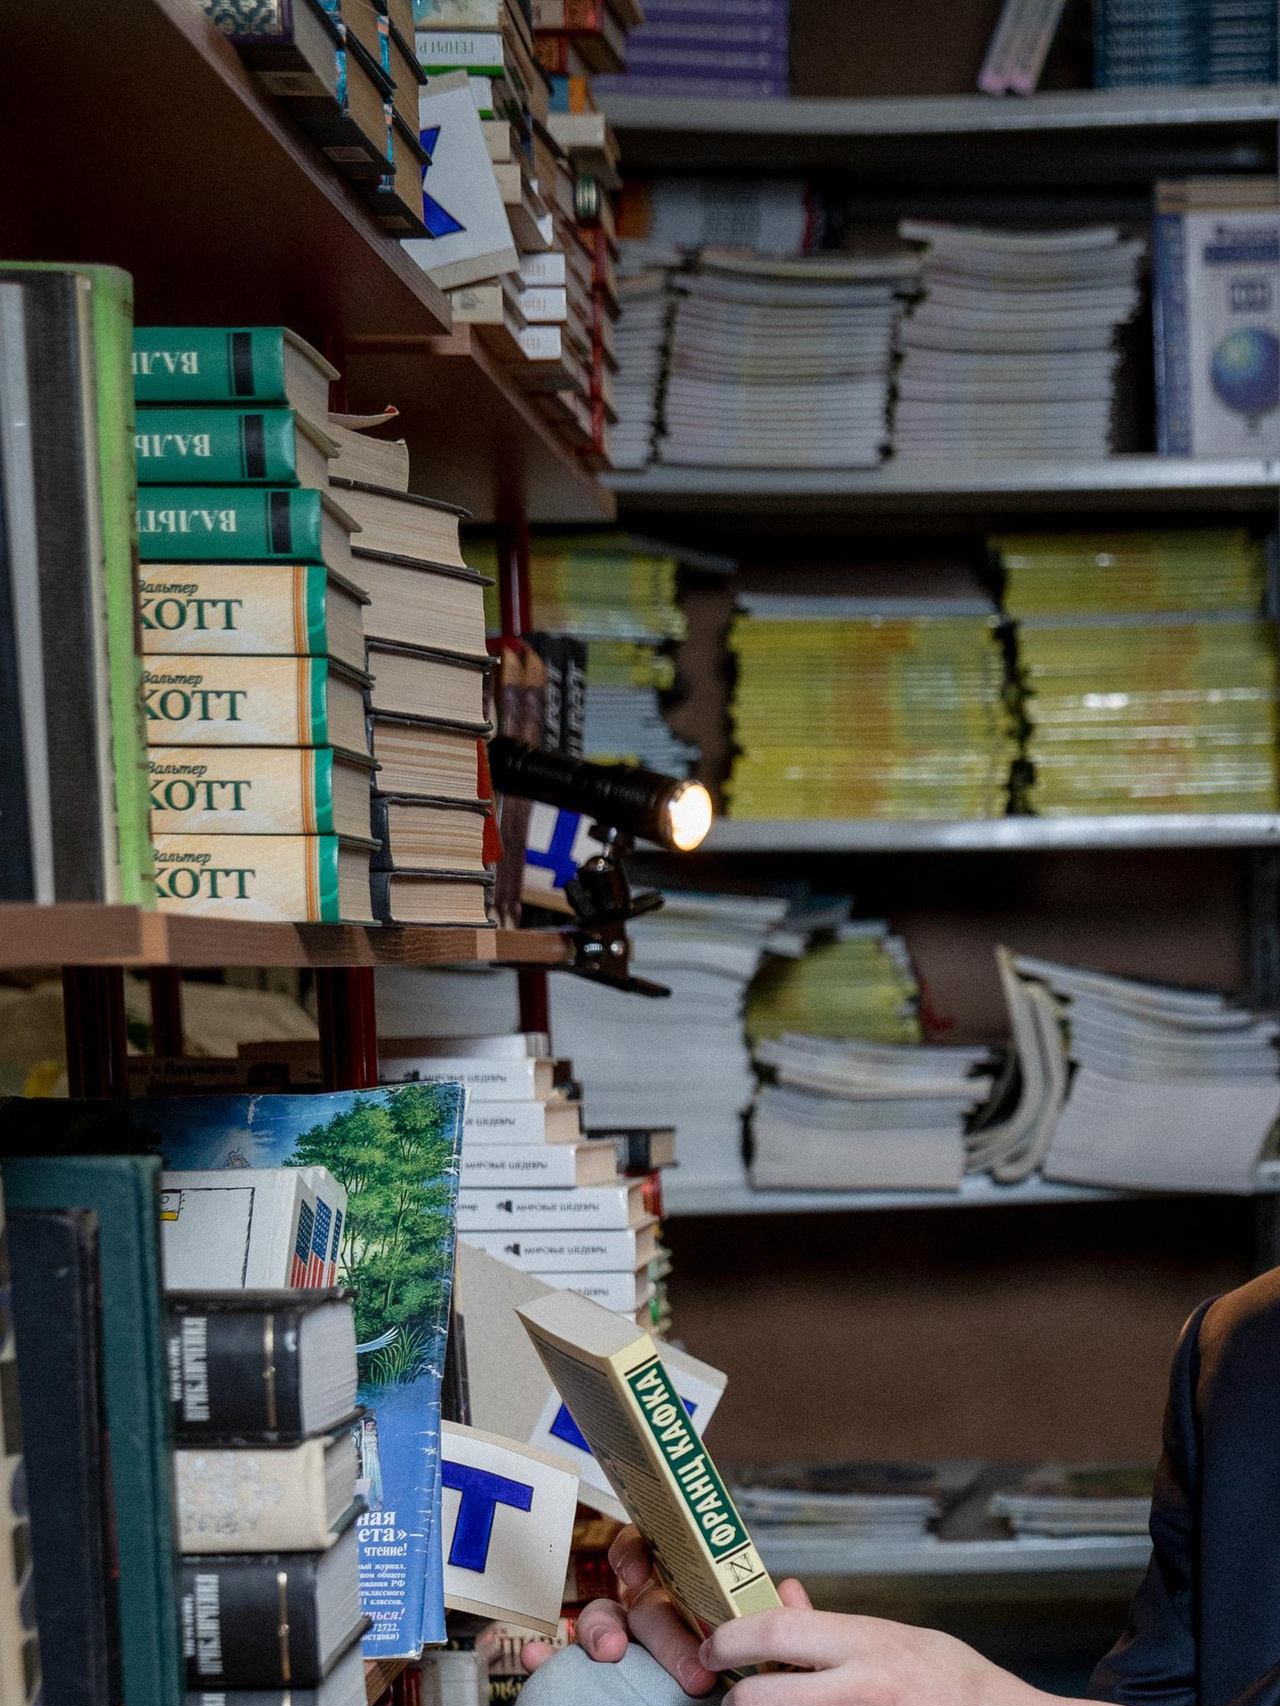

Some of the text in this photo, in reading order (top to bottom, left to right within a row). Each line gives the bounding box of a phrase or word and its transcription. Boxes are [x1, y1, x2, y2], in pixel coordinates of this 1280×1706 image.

[634, 1367, 737, 1547] ФРАНЦ КАФКА
[364, 1543, 408, 1556] чтение!
